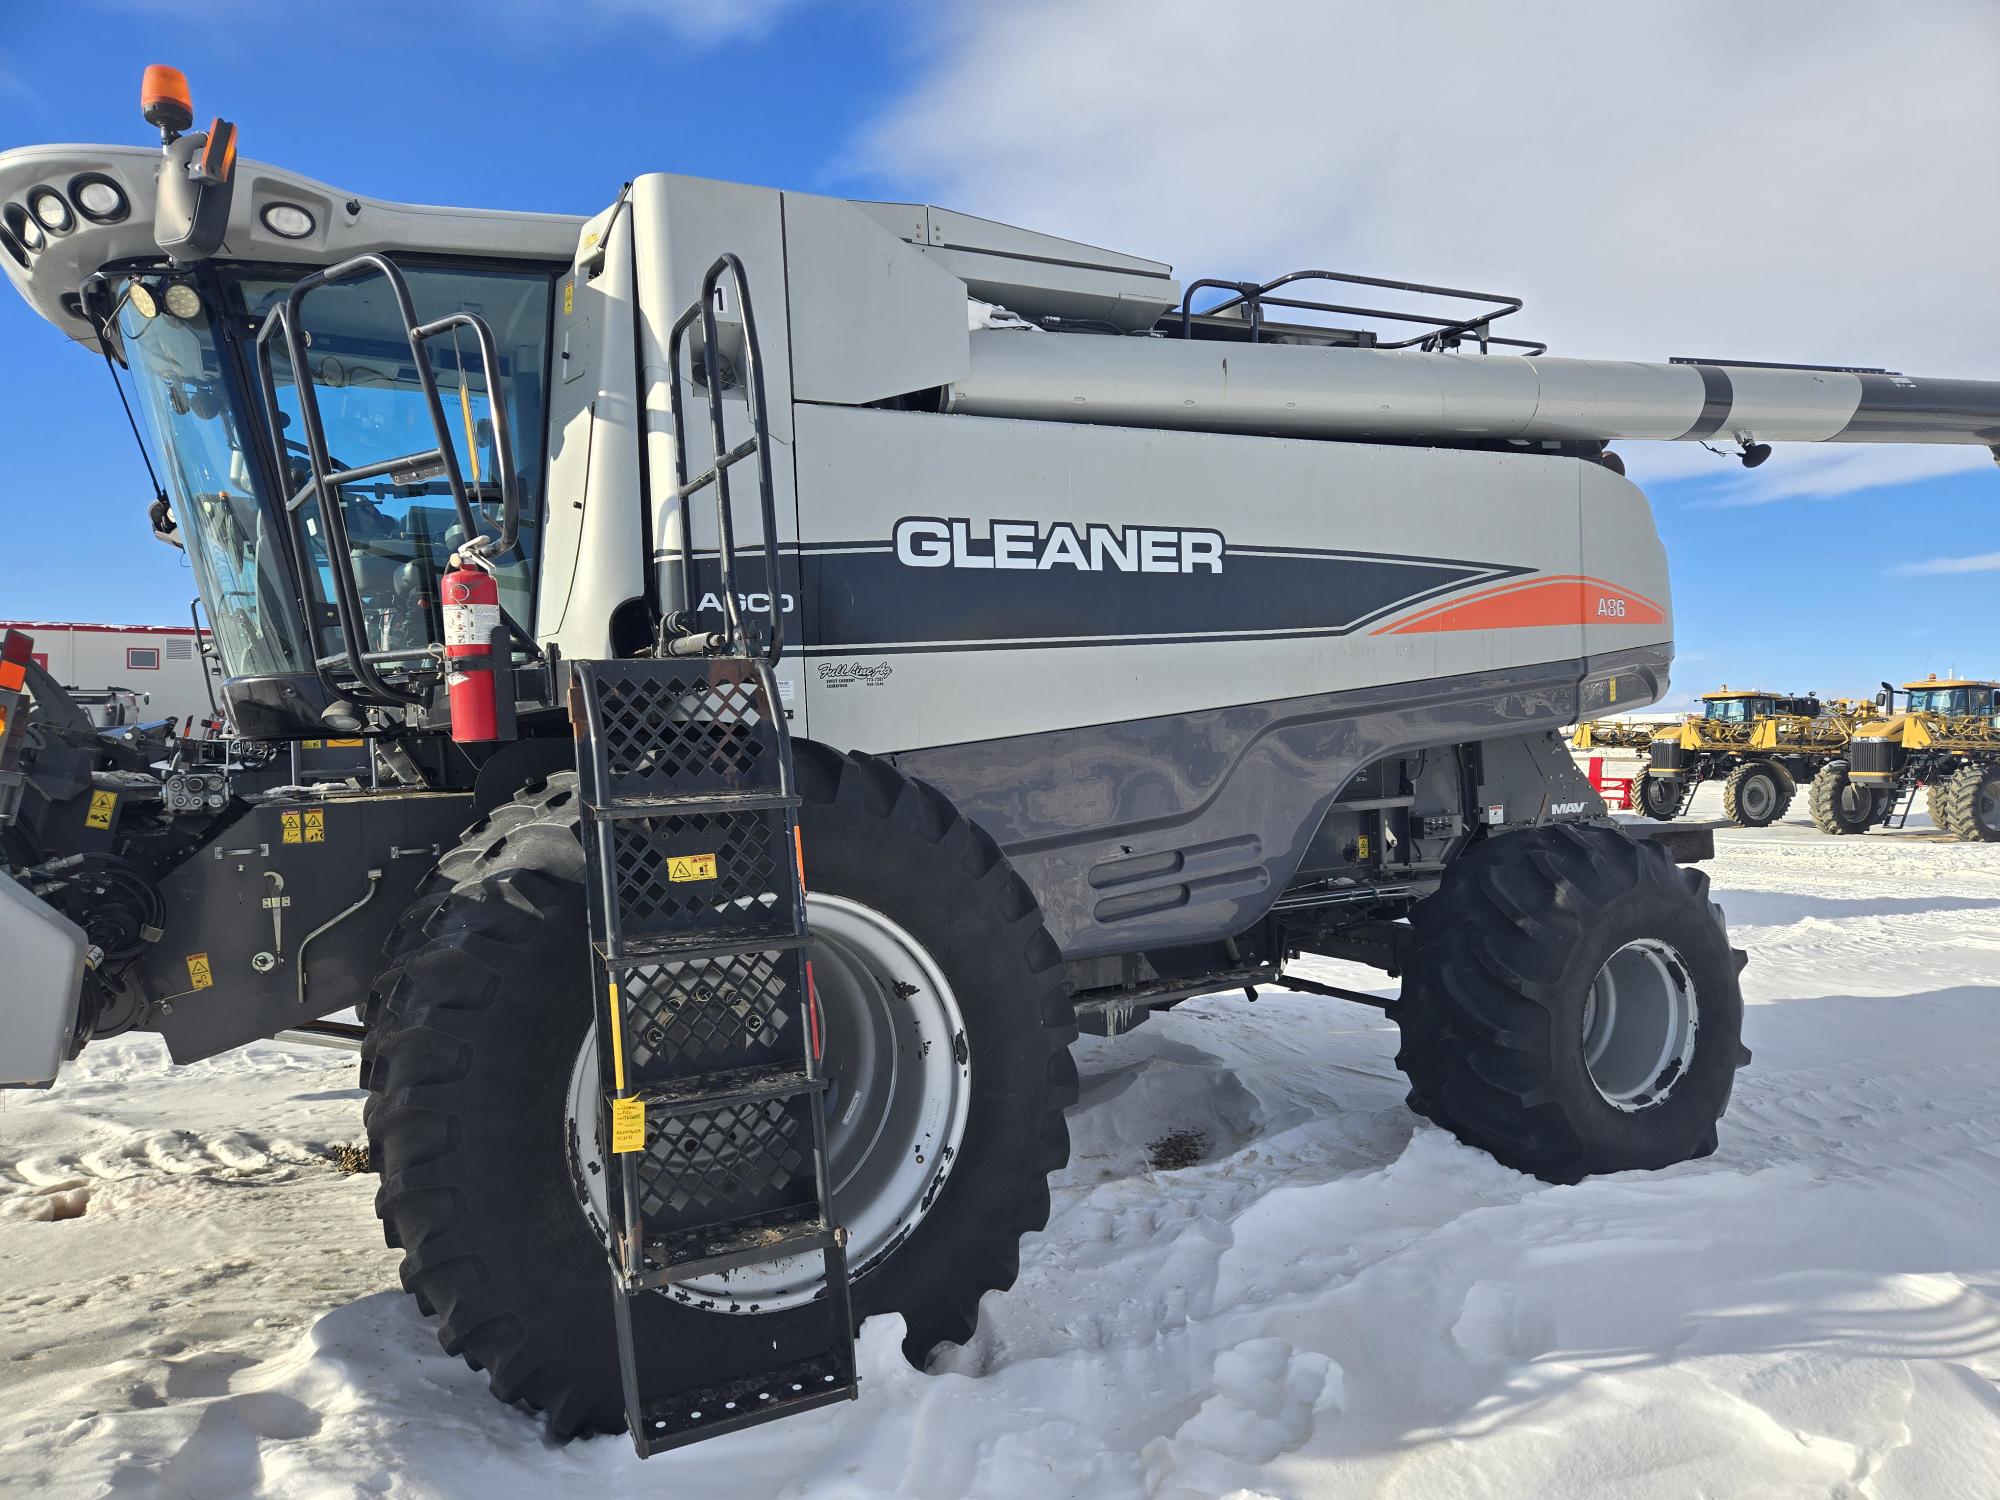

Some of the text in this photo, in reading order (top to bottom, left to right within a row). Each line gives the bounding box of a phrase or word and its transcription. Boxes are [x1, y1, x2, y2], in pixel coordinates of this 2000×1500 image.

[896, 520, 1223, 574] GLEANER
[1597, 598, 1626, 617] A86
[818, 662, 892, 680] Full Line Ag
[1551, 802, 1584, 815] MAV
